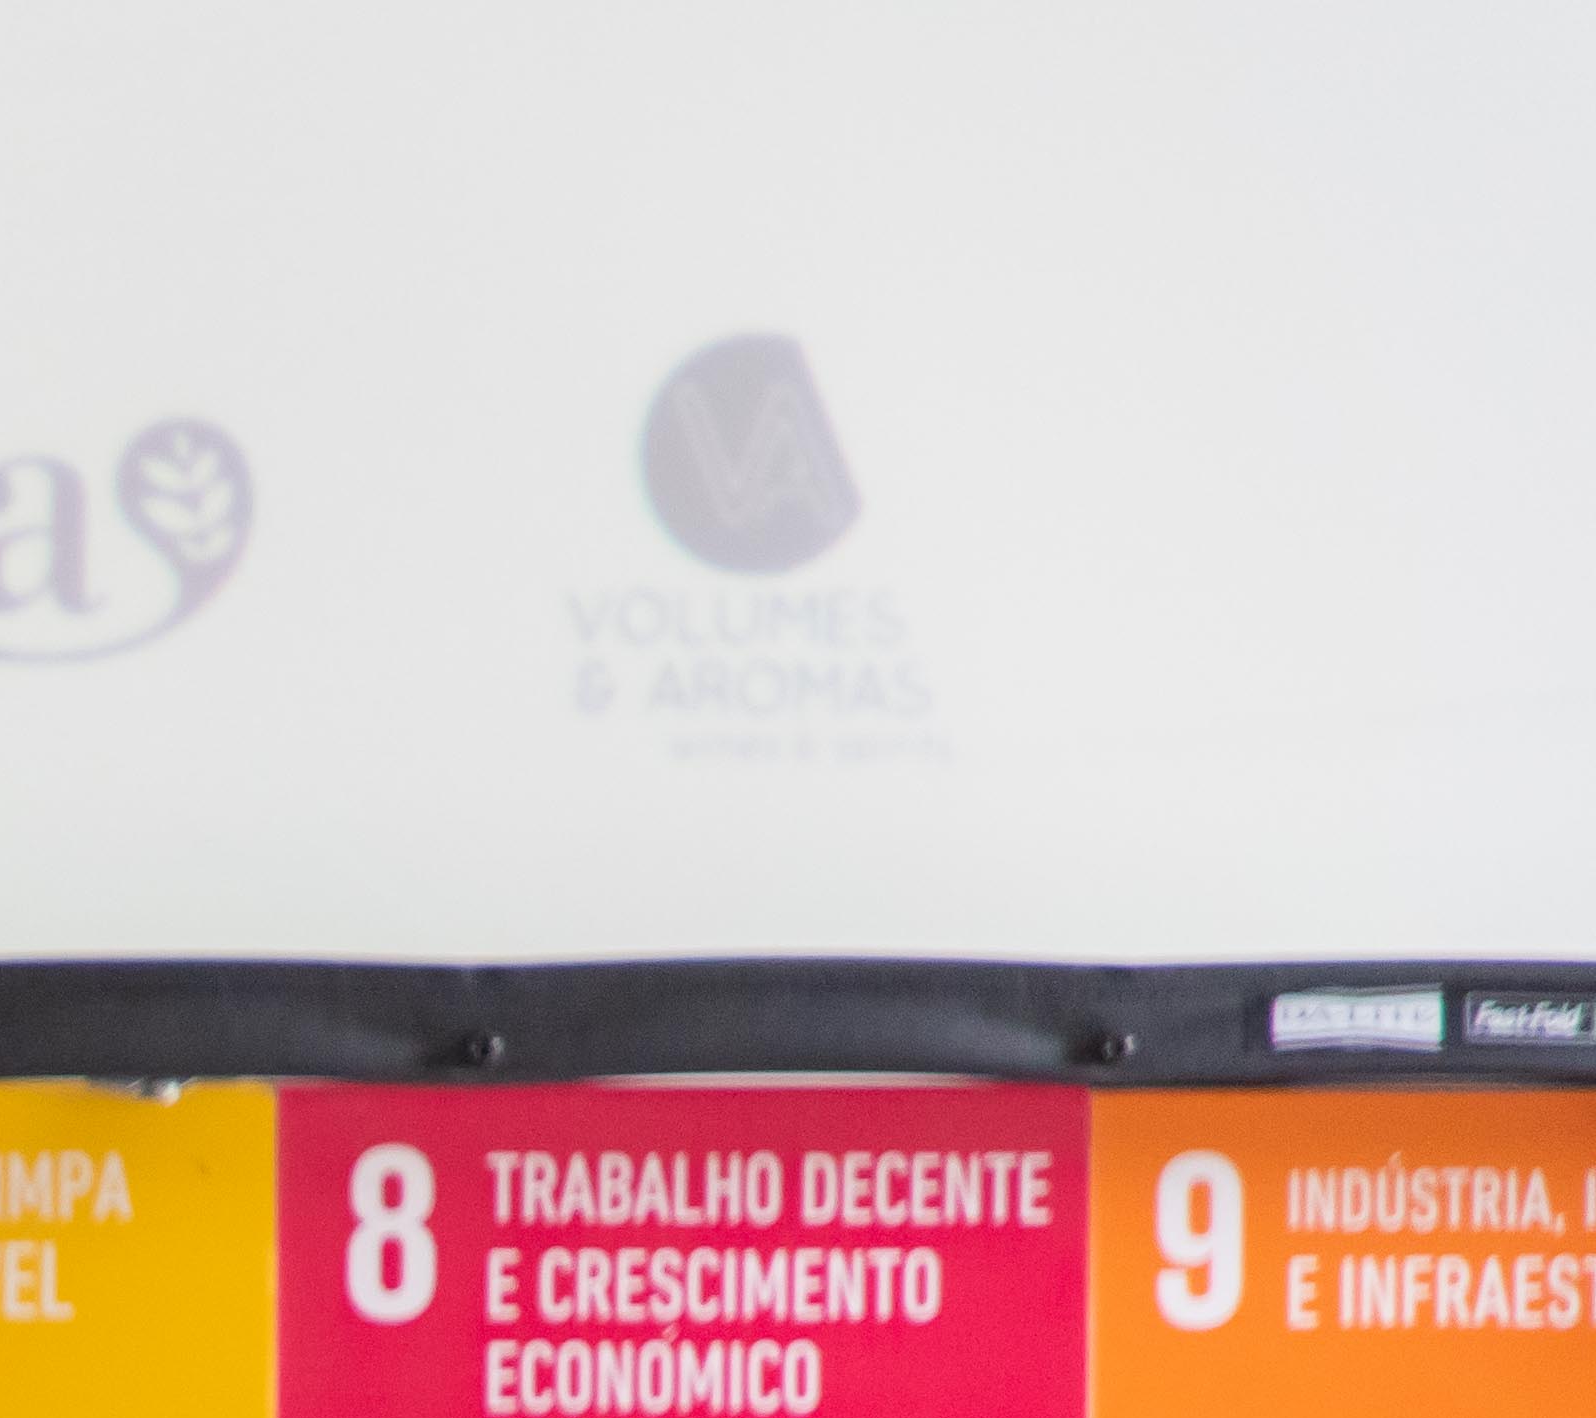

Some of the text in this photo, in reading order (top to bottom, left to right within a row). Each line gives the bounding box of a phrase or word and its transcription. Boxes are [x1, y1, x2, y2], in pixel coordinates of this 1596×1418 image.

[563, 587, 909, 649] VOLUMES
[647, 657, 936, 717] AROMAS
[487, 1151, 1051, 1227] TRABALHO DECENTE
[346, 1144, 437, 1324] 8
[1155, 1151, 1244, 1331] 9
[486, 1247, 941, 1323] E CRESCIMENTO
[1286, 1255, 1317, 1330] E
[485, 1326, 822, 1417] ECONÓMICO
